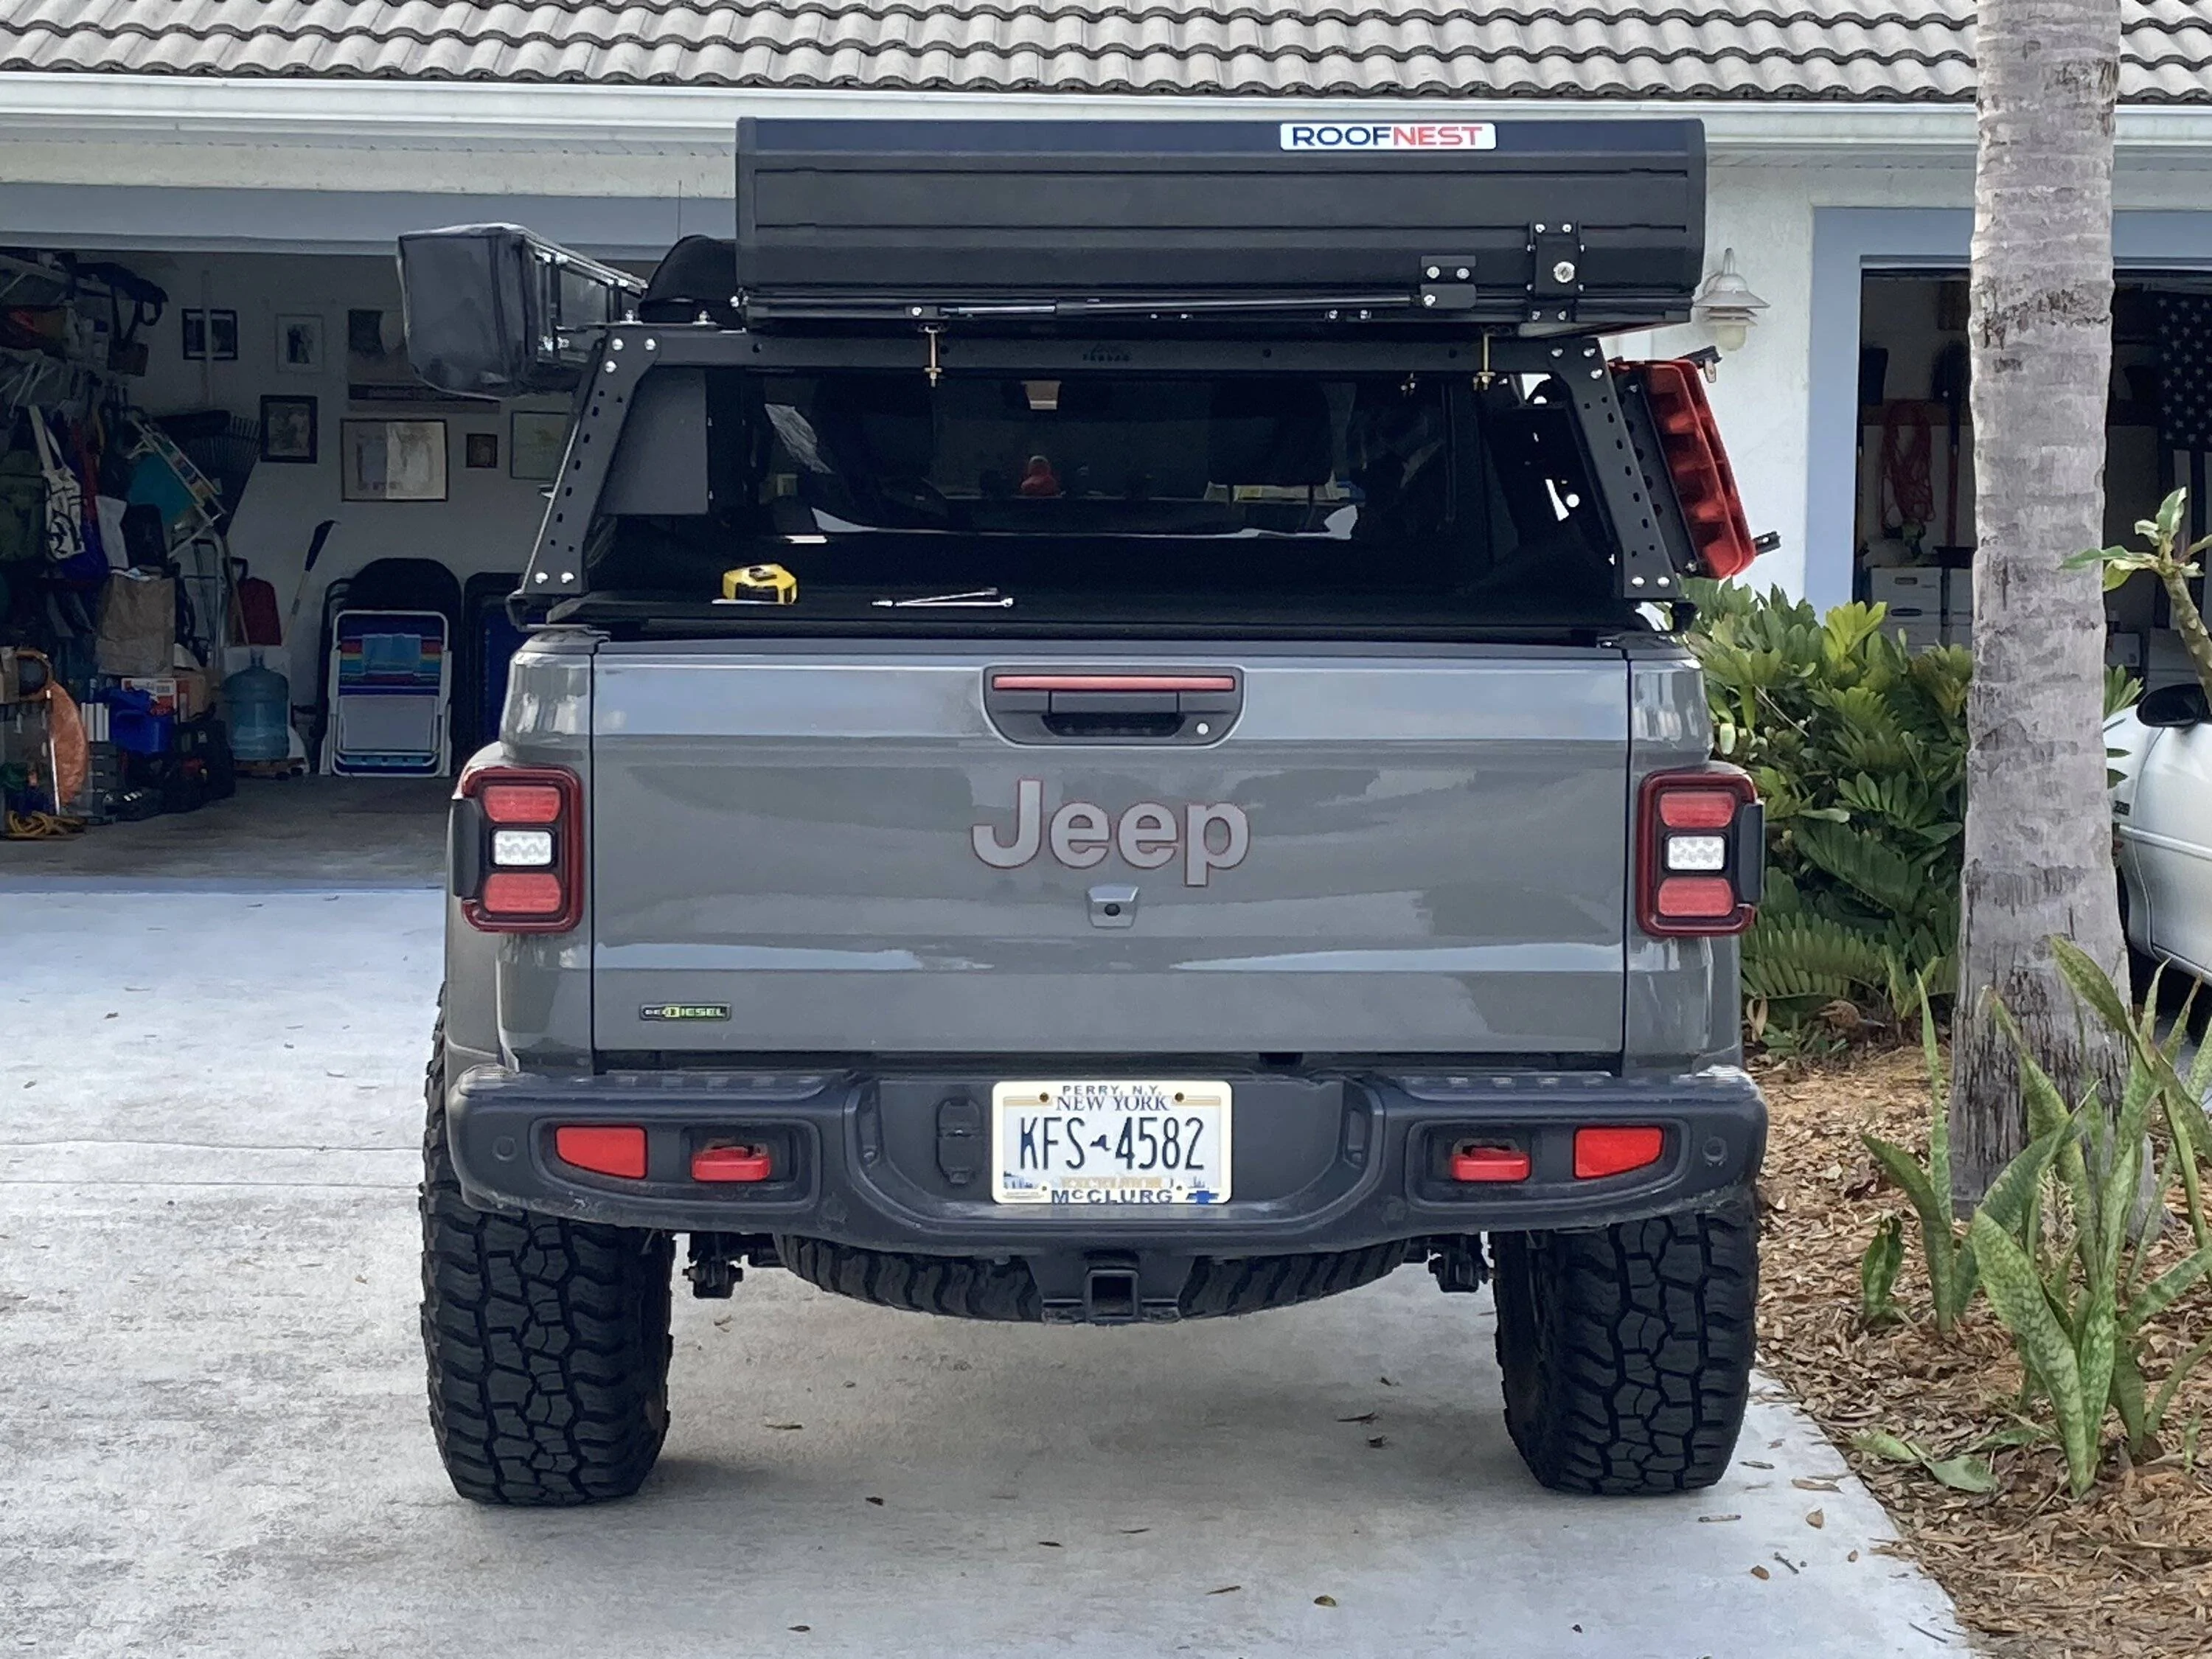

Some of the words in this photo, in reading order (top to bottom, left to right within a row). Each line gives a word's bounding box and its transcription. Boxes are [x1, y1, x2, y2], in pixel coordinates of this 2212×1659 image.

[1292, 126, 1483, 146] ROOFNEST
[971, 778, 1251, 888] Jeep
[1132, 1085, 1162, 1096] N.Y.
[1055, 1096, 1105, 1111] NEW
[1113, 1096, 1171, 1111] YORK
[1115, 1116, 1206, 1170] 4582
